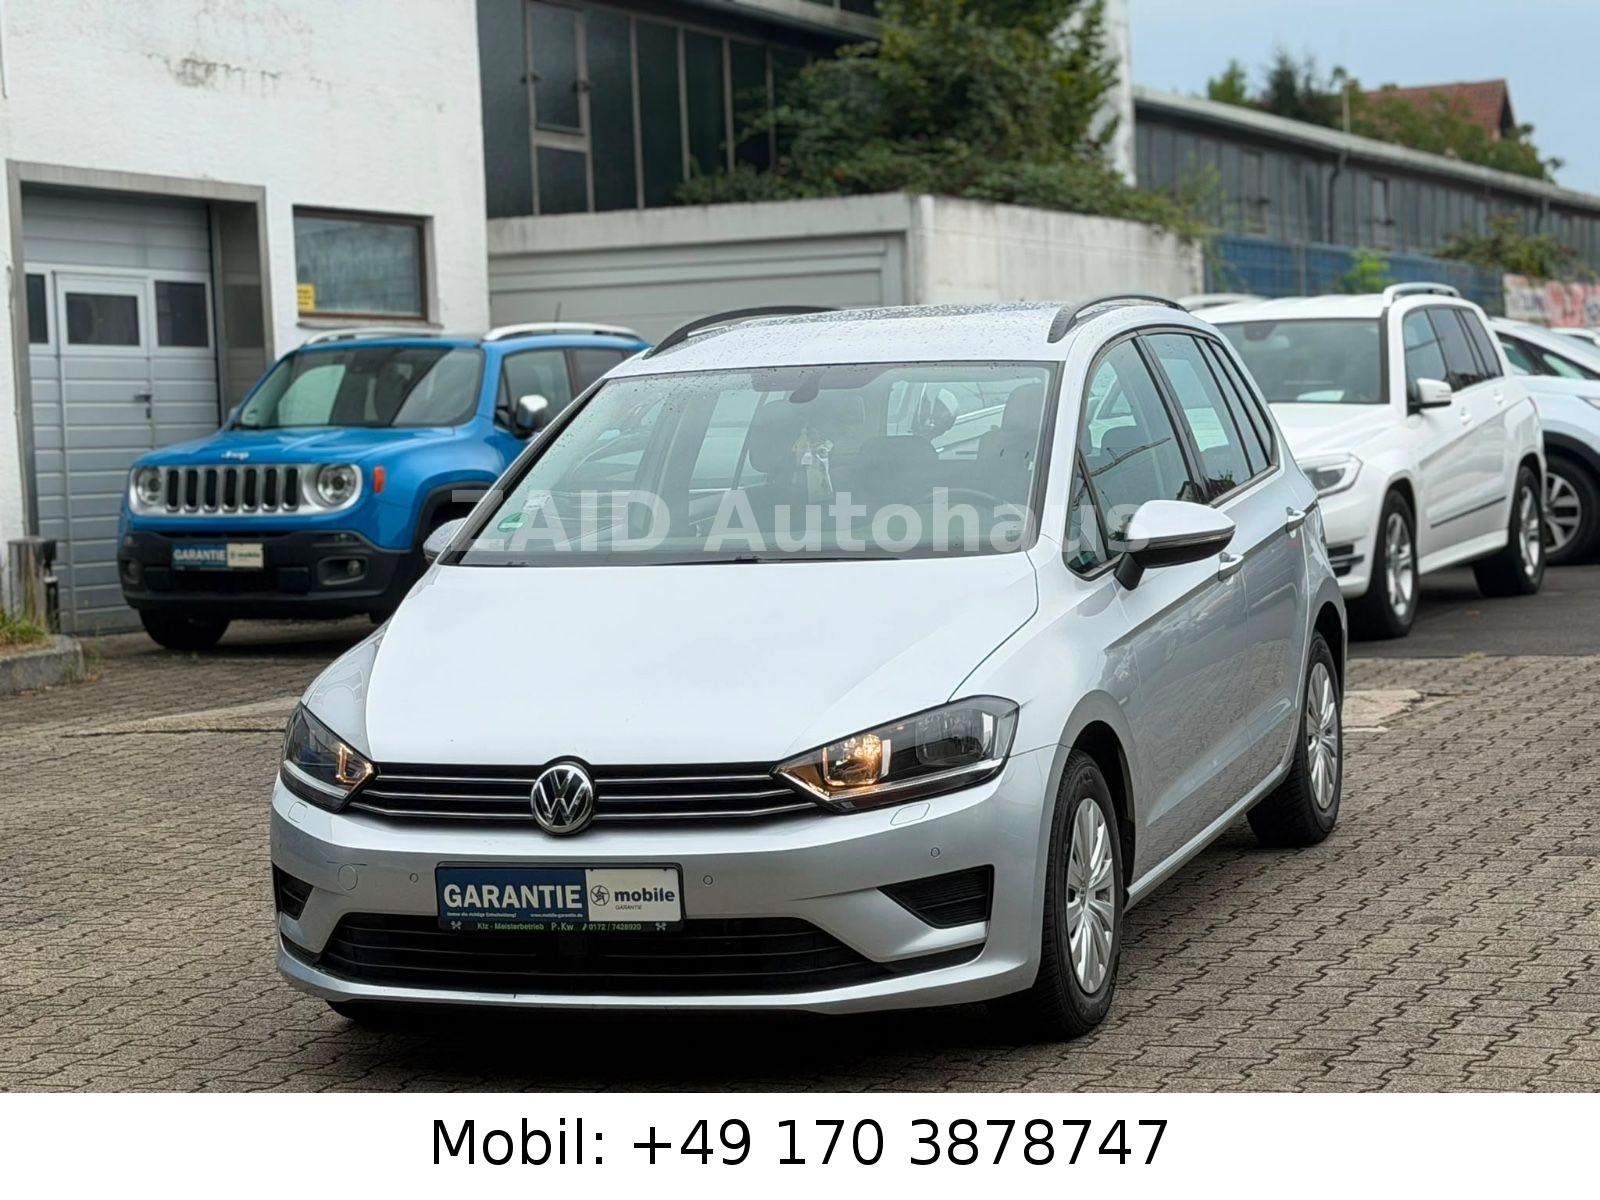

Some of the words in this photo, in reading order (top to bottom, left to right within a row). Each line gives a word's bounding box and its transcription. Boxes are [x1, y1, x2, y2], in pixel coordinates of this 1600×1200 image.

[172, 548, 226, 561] GARANTIE
[443, 884, 583, 909] GARANTIE
[614, 887, 676, 903] mobile
